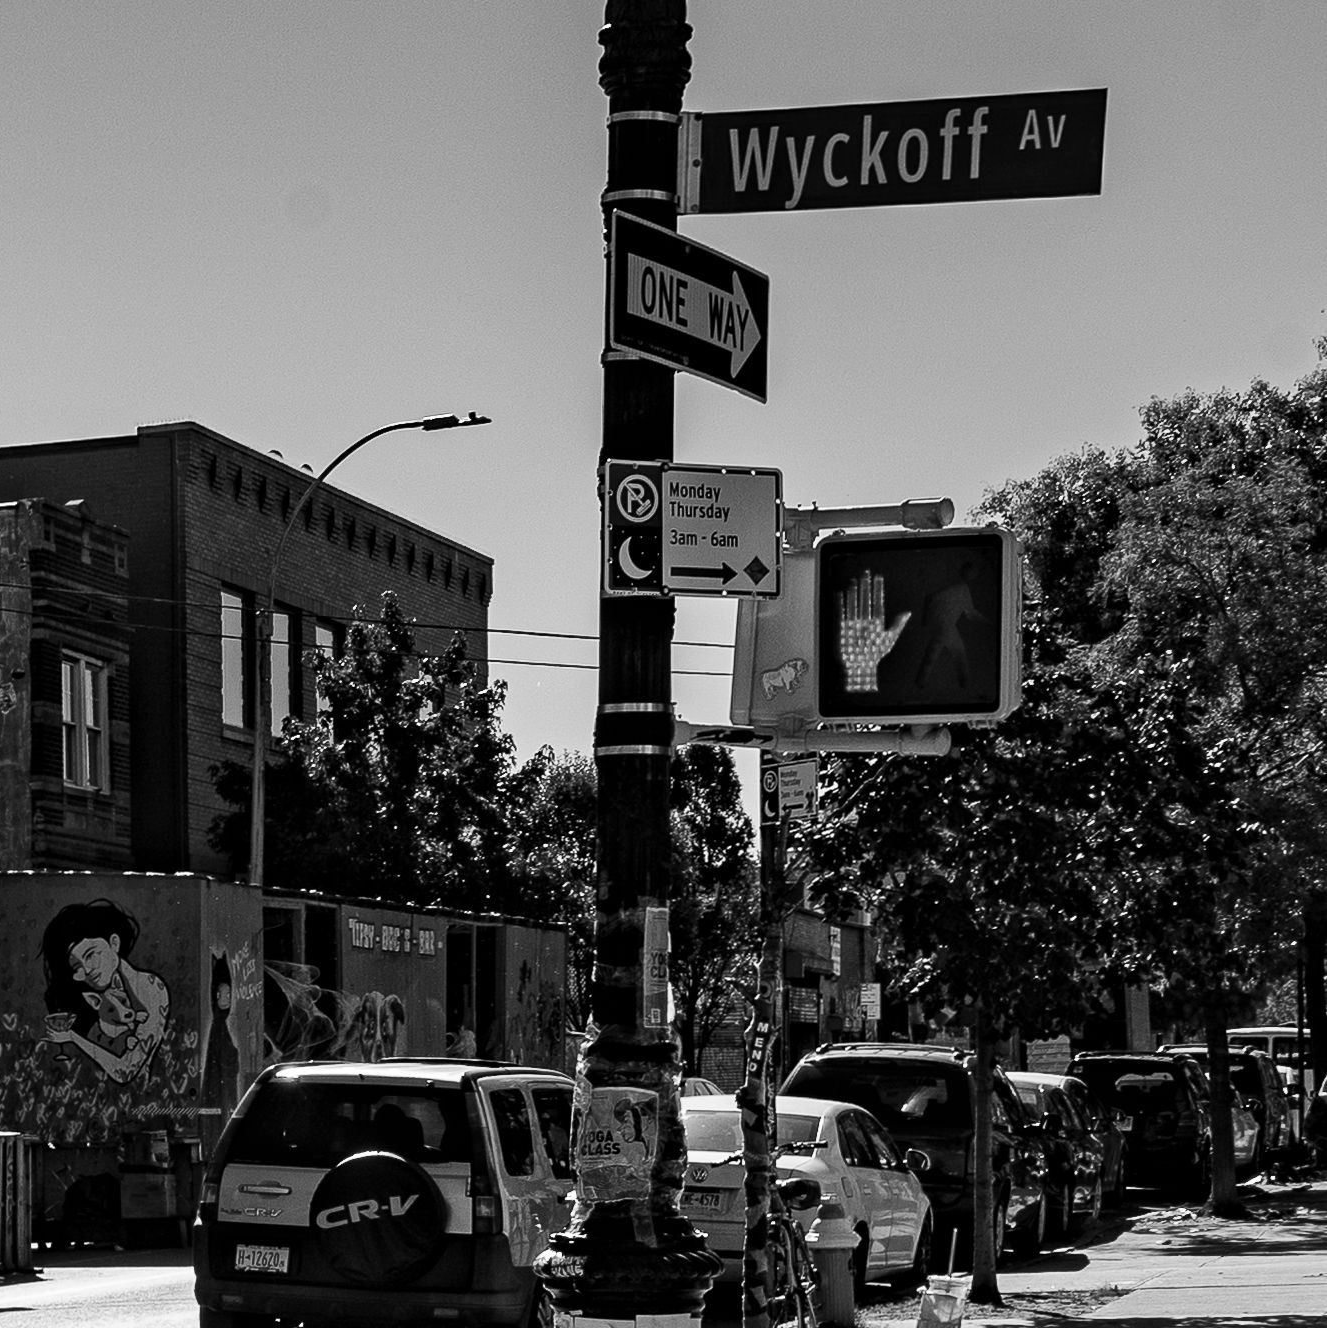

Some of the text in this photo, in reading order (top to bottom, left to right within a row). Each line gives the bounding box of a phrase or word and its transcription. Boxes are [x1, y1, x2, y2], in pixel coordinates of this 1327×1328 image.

[728, 106, 1067, 208] Wyckoff Av
[640, 266, 689, 328] ONE
[708, 291, 751, 352] WAY
[669, 482, 721, 502] Monday
[669, 501, 731, 522] Thursday
[669, 529, 698, 546] 3am
[710, 531, 739, 547] 6am
[580, 1143, 621, 1156] CLASS
[315, 1194, 420, 1230] CR-V
